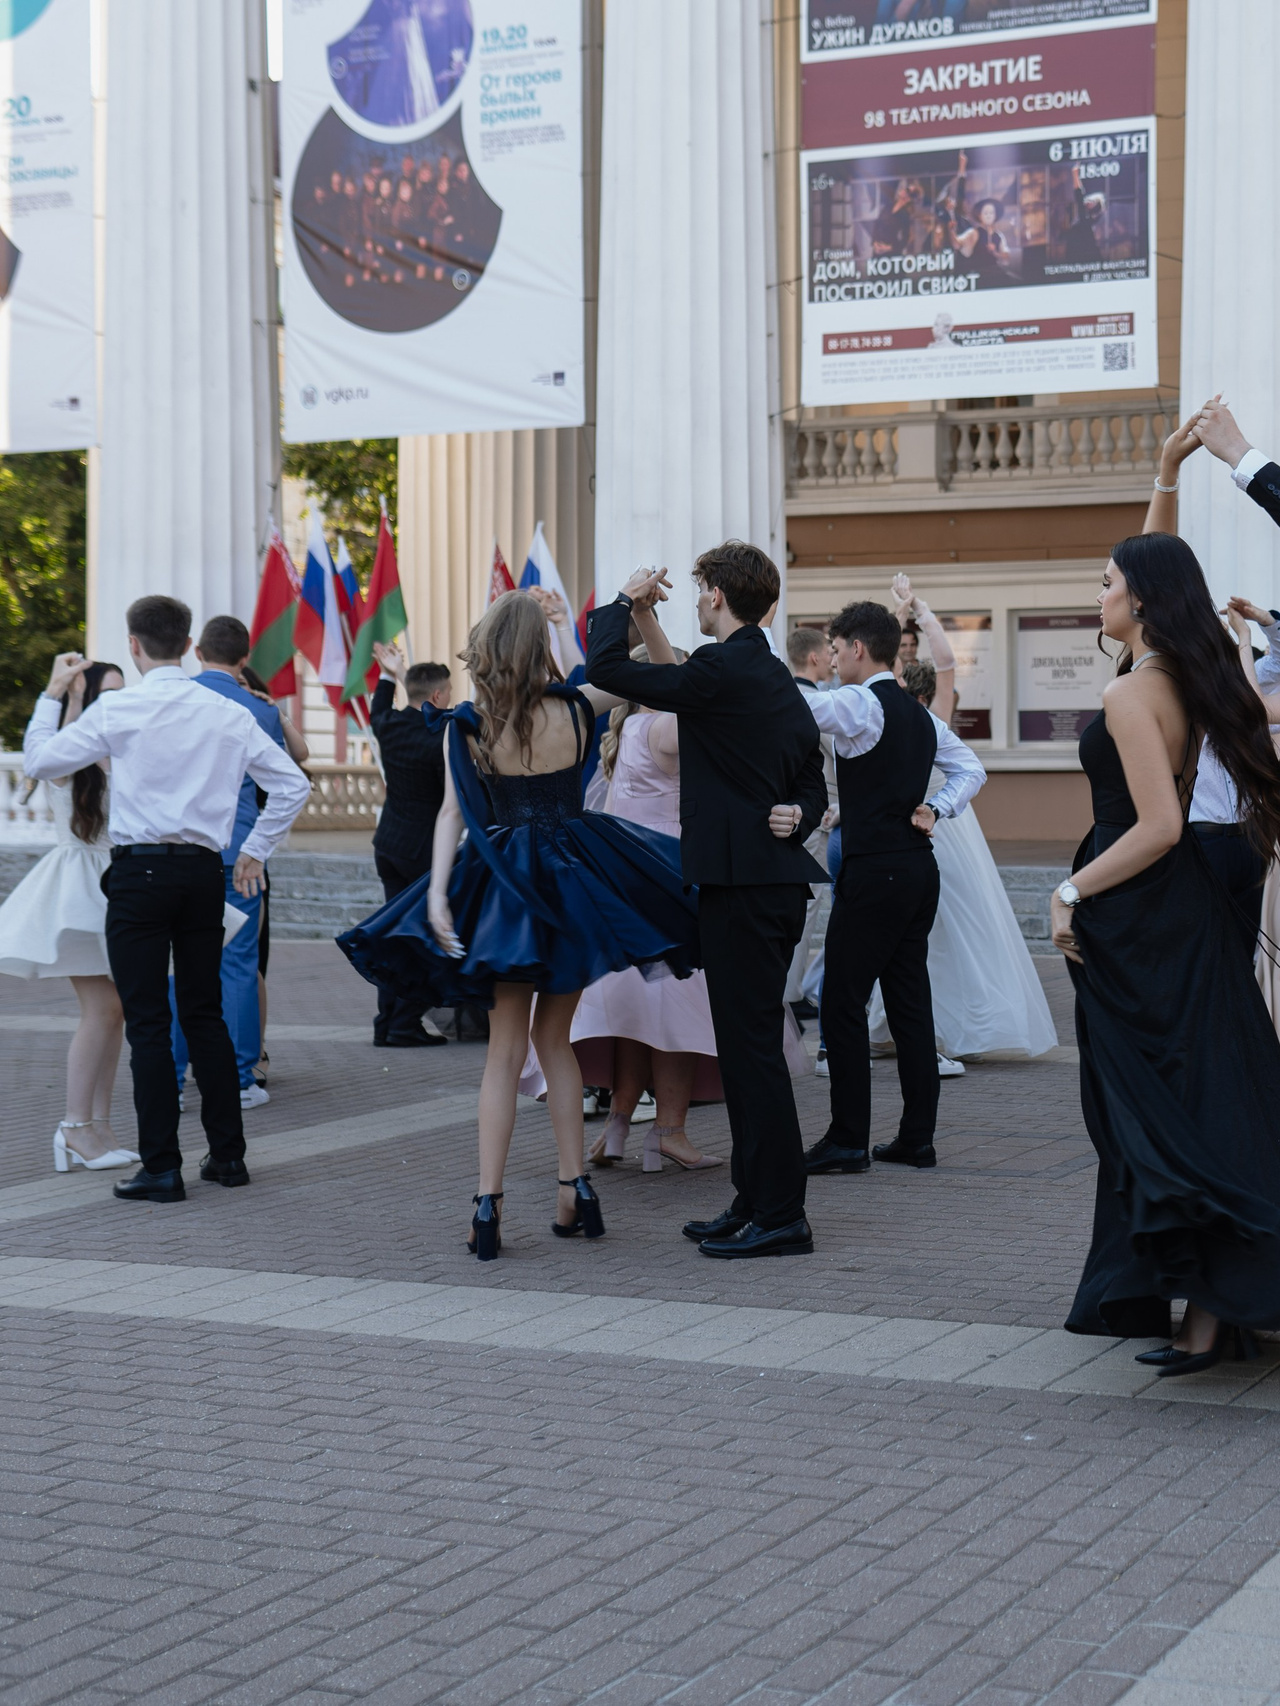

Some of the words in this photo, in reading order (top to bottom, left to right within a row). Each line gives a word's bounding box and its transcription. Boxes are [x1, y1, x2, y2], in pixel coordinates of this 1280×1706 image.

[812, 25, 865, 49] УЖИН
[869, 17, 954, 45] ДУРАКОВ
[480, 73, 500, 92] От
[505, 69, 562, 87] героев
[903, 55, 1043, 95] ЗАКРЫТИЕ
[480, 89, 536, 108] былых
[863, 110, 885, 128] 98
[889, 97, 1019, 127] ТЕАТРАЛЬНОГО
[1022, 89, 1091, 112] СЕЗОНА
[480, 106, 541, 127] времен
[1049, 144, 1063, 162] 6
[1070, 134, 1148, 159] ИЮЛЯ
[1077, 162, 1120, 180] 18:00
[813, 260, 861, 283] ДОМ,
[866, 249, 954, 277] КОТОРЫЙ
[813, 276, 913, 302] ПОСТРОИЛ
[917, 273, 980, 296] СВИФТ
